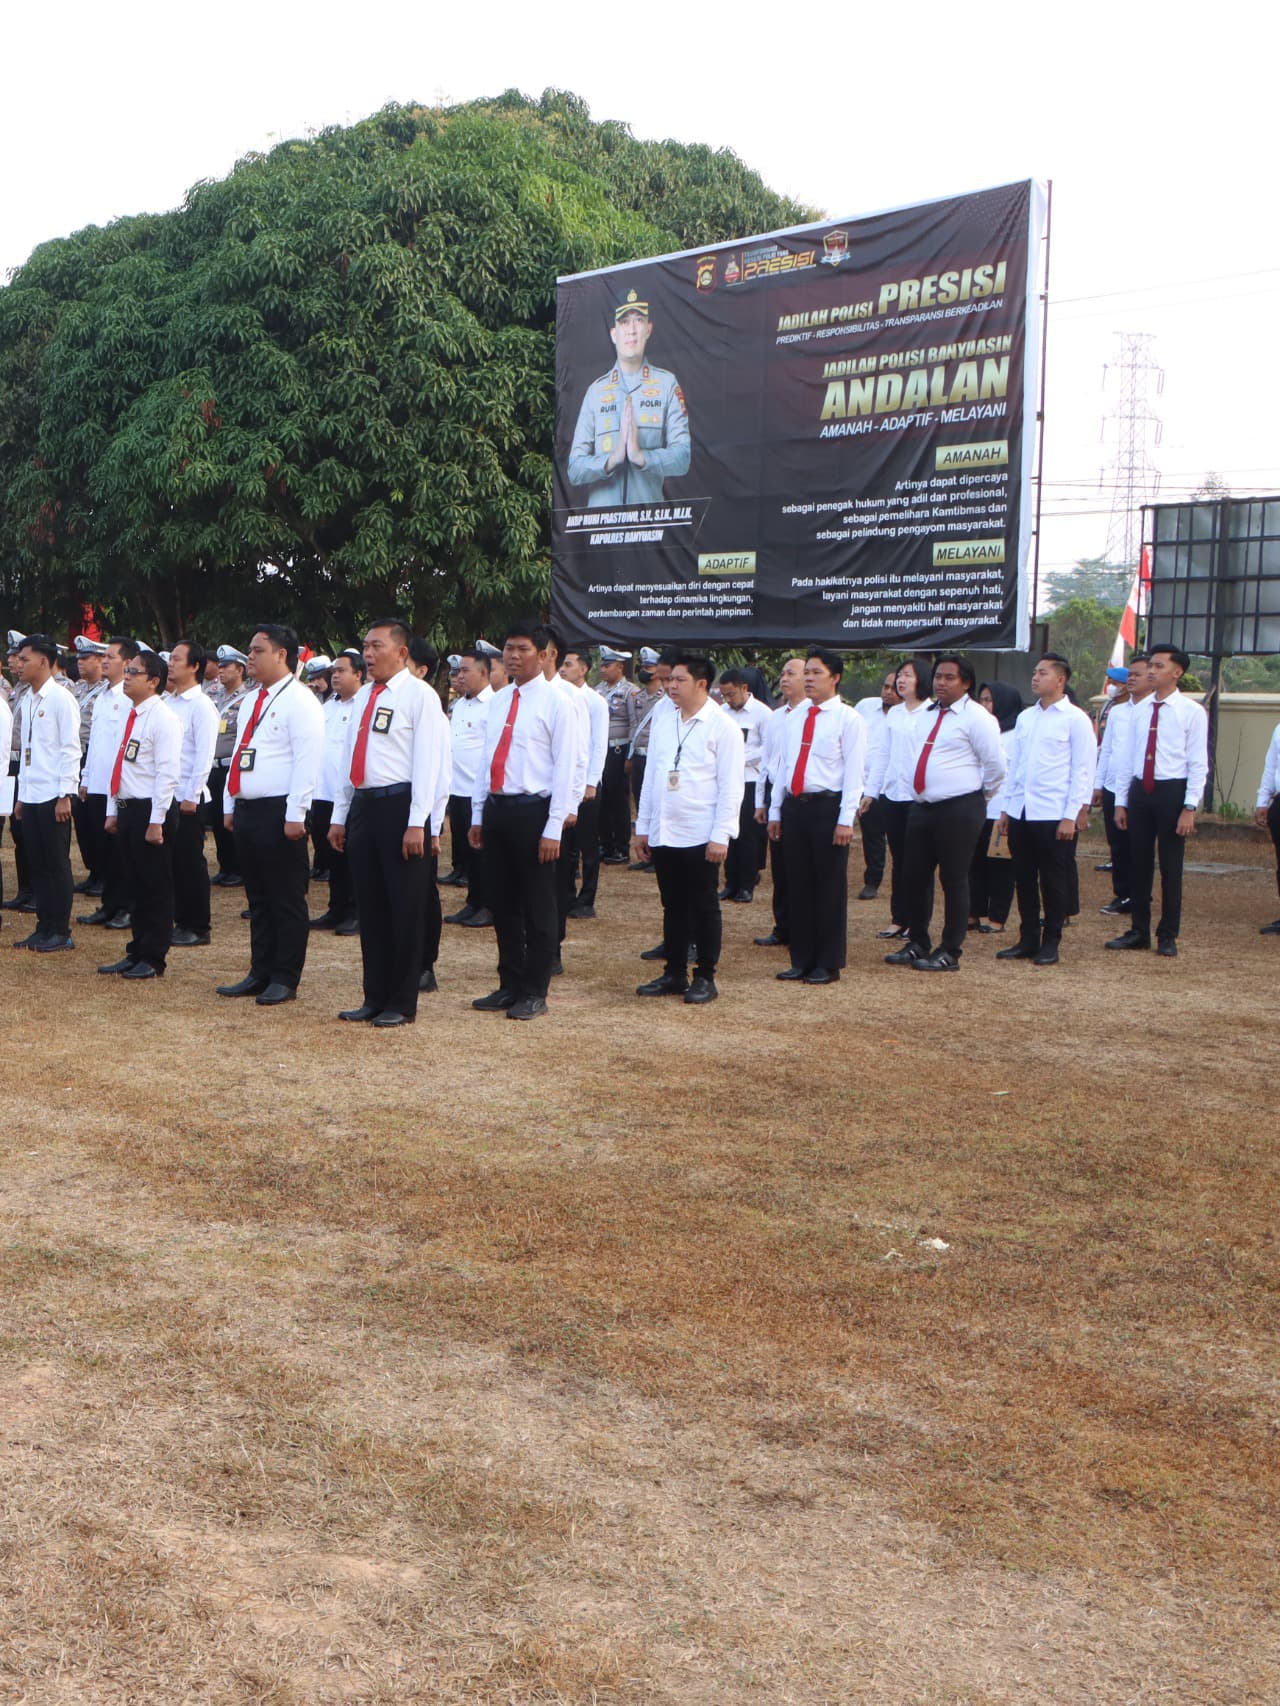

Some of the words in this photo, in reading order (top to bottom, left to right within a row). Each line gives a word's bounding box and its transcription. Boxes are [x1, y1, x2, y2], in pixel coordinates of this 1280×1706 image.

[744, 250, 816, 277] PRESISI
[777, 309, 829, 332] JADILAH
[830, 301, 873, 324] POLISI
[878, 261, 1007, 315] PRESISI
[776, 332, 813, 345] PREDIKTIF
[817, 321, 880, 338] RESPONSIBILITAS
[884, 310, 945, 328] TRANSPARANSI
[945, 300, 1004, 317] BERKEADILAN
[822, 356, 877, 378] JADILAH
[879, 349, 925, 370] POLISI
[928, 335, 1012, 363] BANYUASIN
[820, 356, 1010, 421] ANDALAN
[601, 405, 617, 413] RURI
[640, 400, 662, 408] POLRI
[820, 420, 873, 439] AMANAH
[880, 412, 934, 432] ADAPTIF
[941, 402, 1007, 424] MELAYANI
[944, 447, 1001, 465] AMANAH
[895, 478, 928, 492] Artinya
[930, 476, 957, 489] dapat
[960, 472, 1008, 486] dipercaya
[782, 502, 815, 515] sebagai
[817, 498, 854, 513] penegak
[856, 498, 885, 509] hukum
[887, 497, 909, 509] yang
[912, 494, 928, 504] adil
[930, 492, 947, 502] dan
[950, 487, 1008, 502] profesional,
[843, 512, 878, 525] sebagai
[879, 509, 930, 523] pemelihara
[933, 506, 986, 518] Kamtibmas
[988, 503, 1007, 513] dan
[816, 528, 850, 541] sebagai
[852, 526, 896, 539] pelindung
[898, 523, 946, 537] pengayom
[947, 519, 1006, 533] masyarakat.
[937, 546, 1000, 561] MELAYANI
[704, 557, 750, 570] ADAPTIF
[588, 583, 612, 593] Artinya
[614, 583, 634, 593] dapat
[636, 582, 687, 592] menyesuaikan
[689, 581, 701, 590] diri
[703, 581, 730, 592] dengan
[732, 580, 755, 590] cepat
[792, 578, 813, 587] Pada
[815, 577, 862, 587] hakikatnya
[864, 575, 888, 587] polisi
[890, 574, 901, 584] itu
[903, 572, 944, 585] melayani
[946, 569, 1005, 582] masyarakat,
[640, 596, 673, 606] terhadap
[674, 595, 708, 604] dinamika
[710, 594, 754, 605] lingkungan,
[823, 591, 849, 603] layani
[851, 589, 903, 602] masyarakat
[904, 588, 937, 600] dengan
[939, 587, 980, 598] sepenuh
[983, 585, 1004, 596] hati,
[588, 610, 640, 620] perkembangan
[642, 610, 666, 618] zaman
[667, 609, 681, 617] dan
[682, 608, 714, 619] perintah
[715, 608, 754, 619] pimpinan.
[851, 605, 881, 616] jangan
[883, 602, 926, 614] menyakiti
[928, 602, 946, 612] hati
[948, 600, 1003, 613] masyarakat
[843, 619, 859, 629] dan
[862, 618, 883, 628] tidak
[885, 618, 943, 630] mempersulit
[945, 615, 1002, 628] masyarakat.
